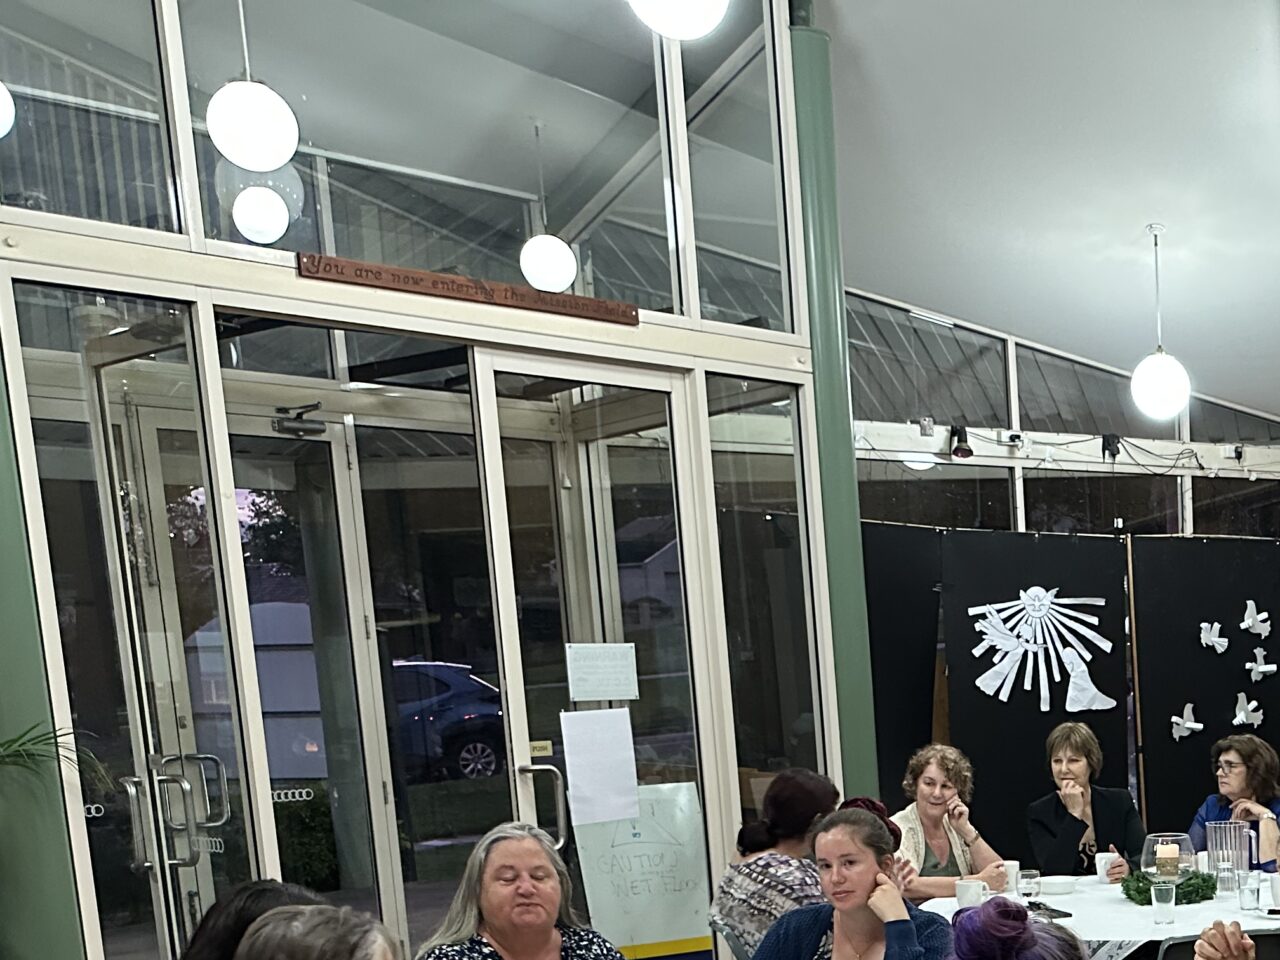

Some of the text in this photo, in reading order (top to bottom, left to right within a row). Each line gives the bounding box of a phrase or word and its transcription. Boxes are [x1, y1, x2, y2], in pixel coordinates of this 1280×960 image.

[306, 253, 345, 275] You
[354, 267, 384, 281] are
[391, 273, 424, 287] now
[430, 278, 494, 302] entering
[504, 287, 526, 303] the
[611, 876, 653, 898] WET
